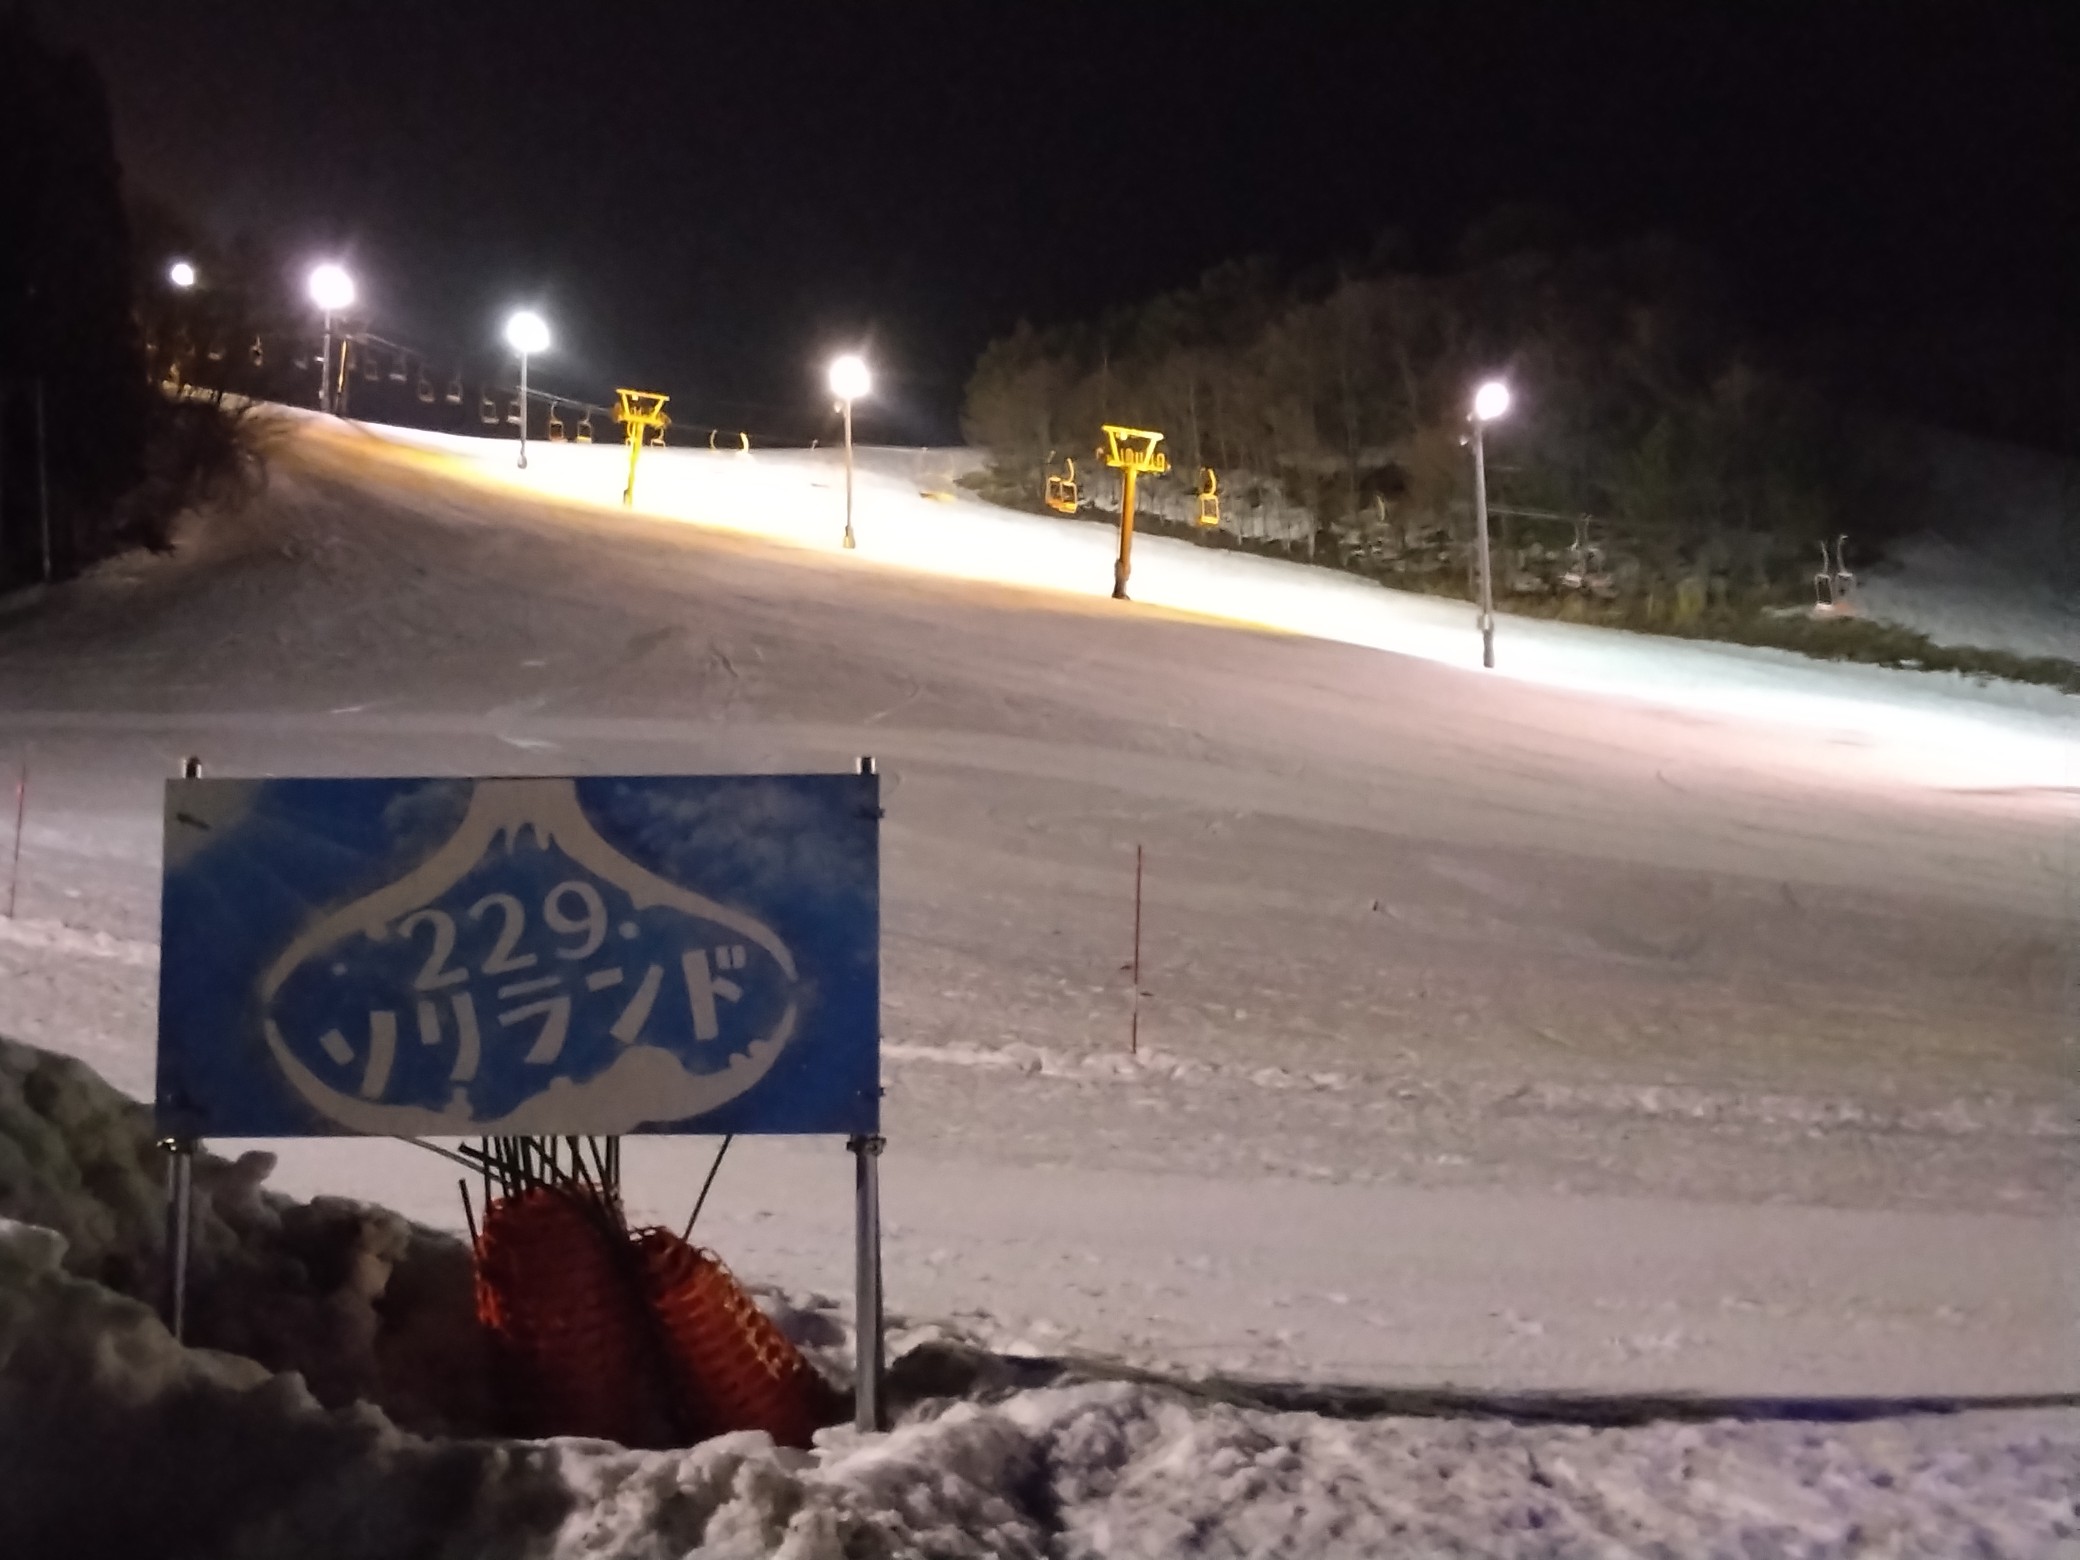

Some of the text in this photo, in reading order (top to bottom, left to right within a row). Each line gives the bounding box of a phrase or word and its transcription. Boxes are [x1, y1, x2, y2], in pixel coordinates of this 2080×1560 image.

[398, 881, 607, 991] 229
[319, 945, 746, 1099] ソリランド
